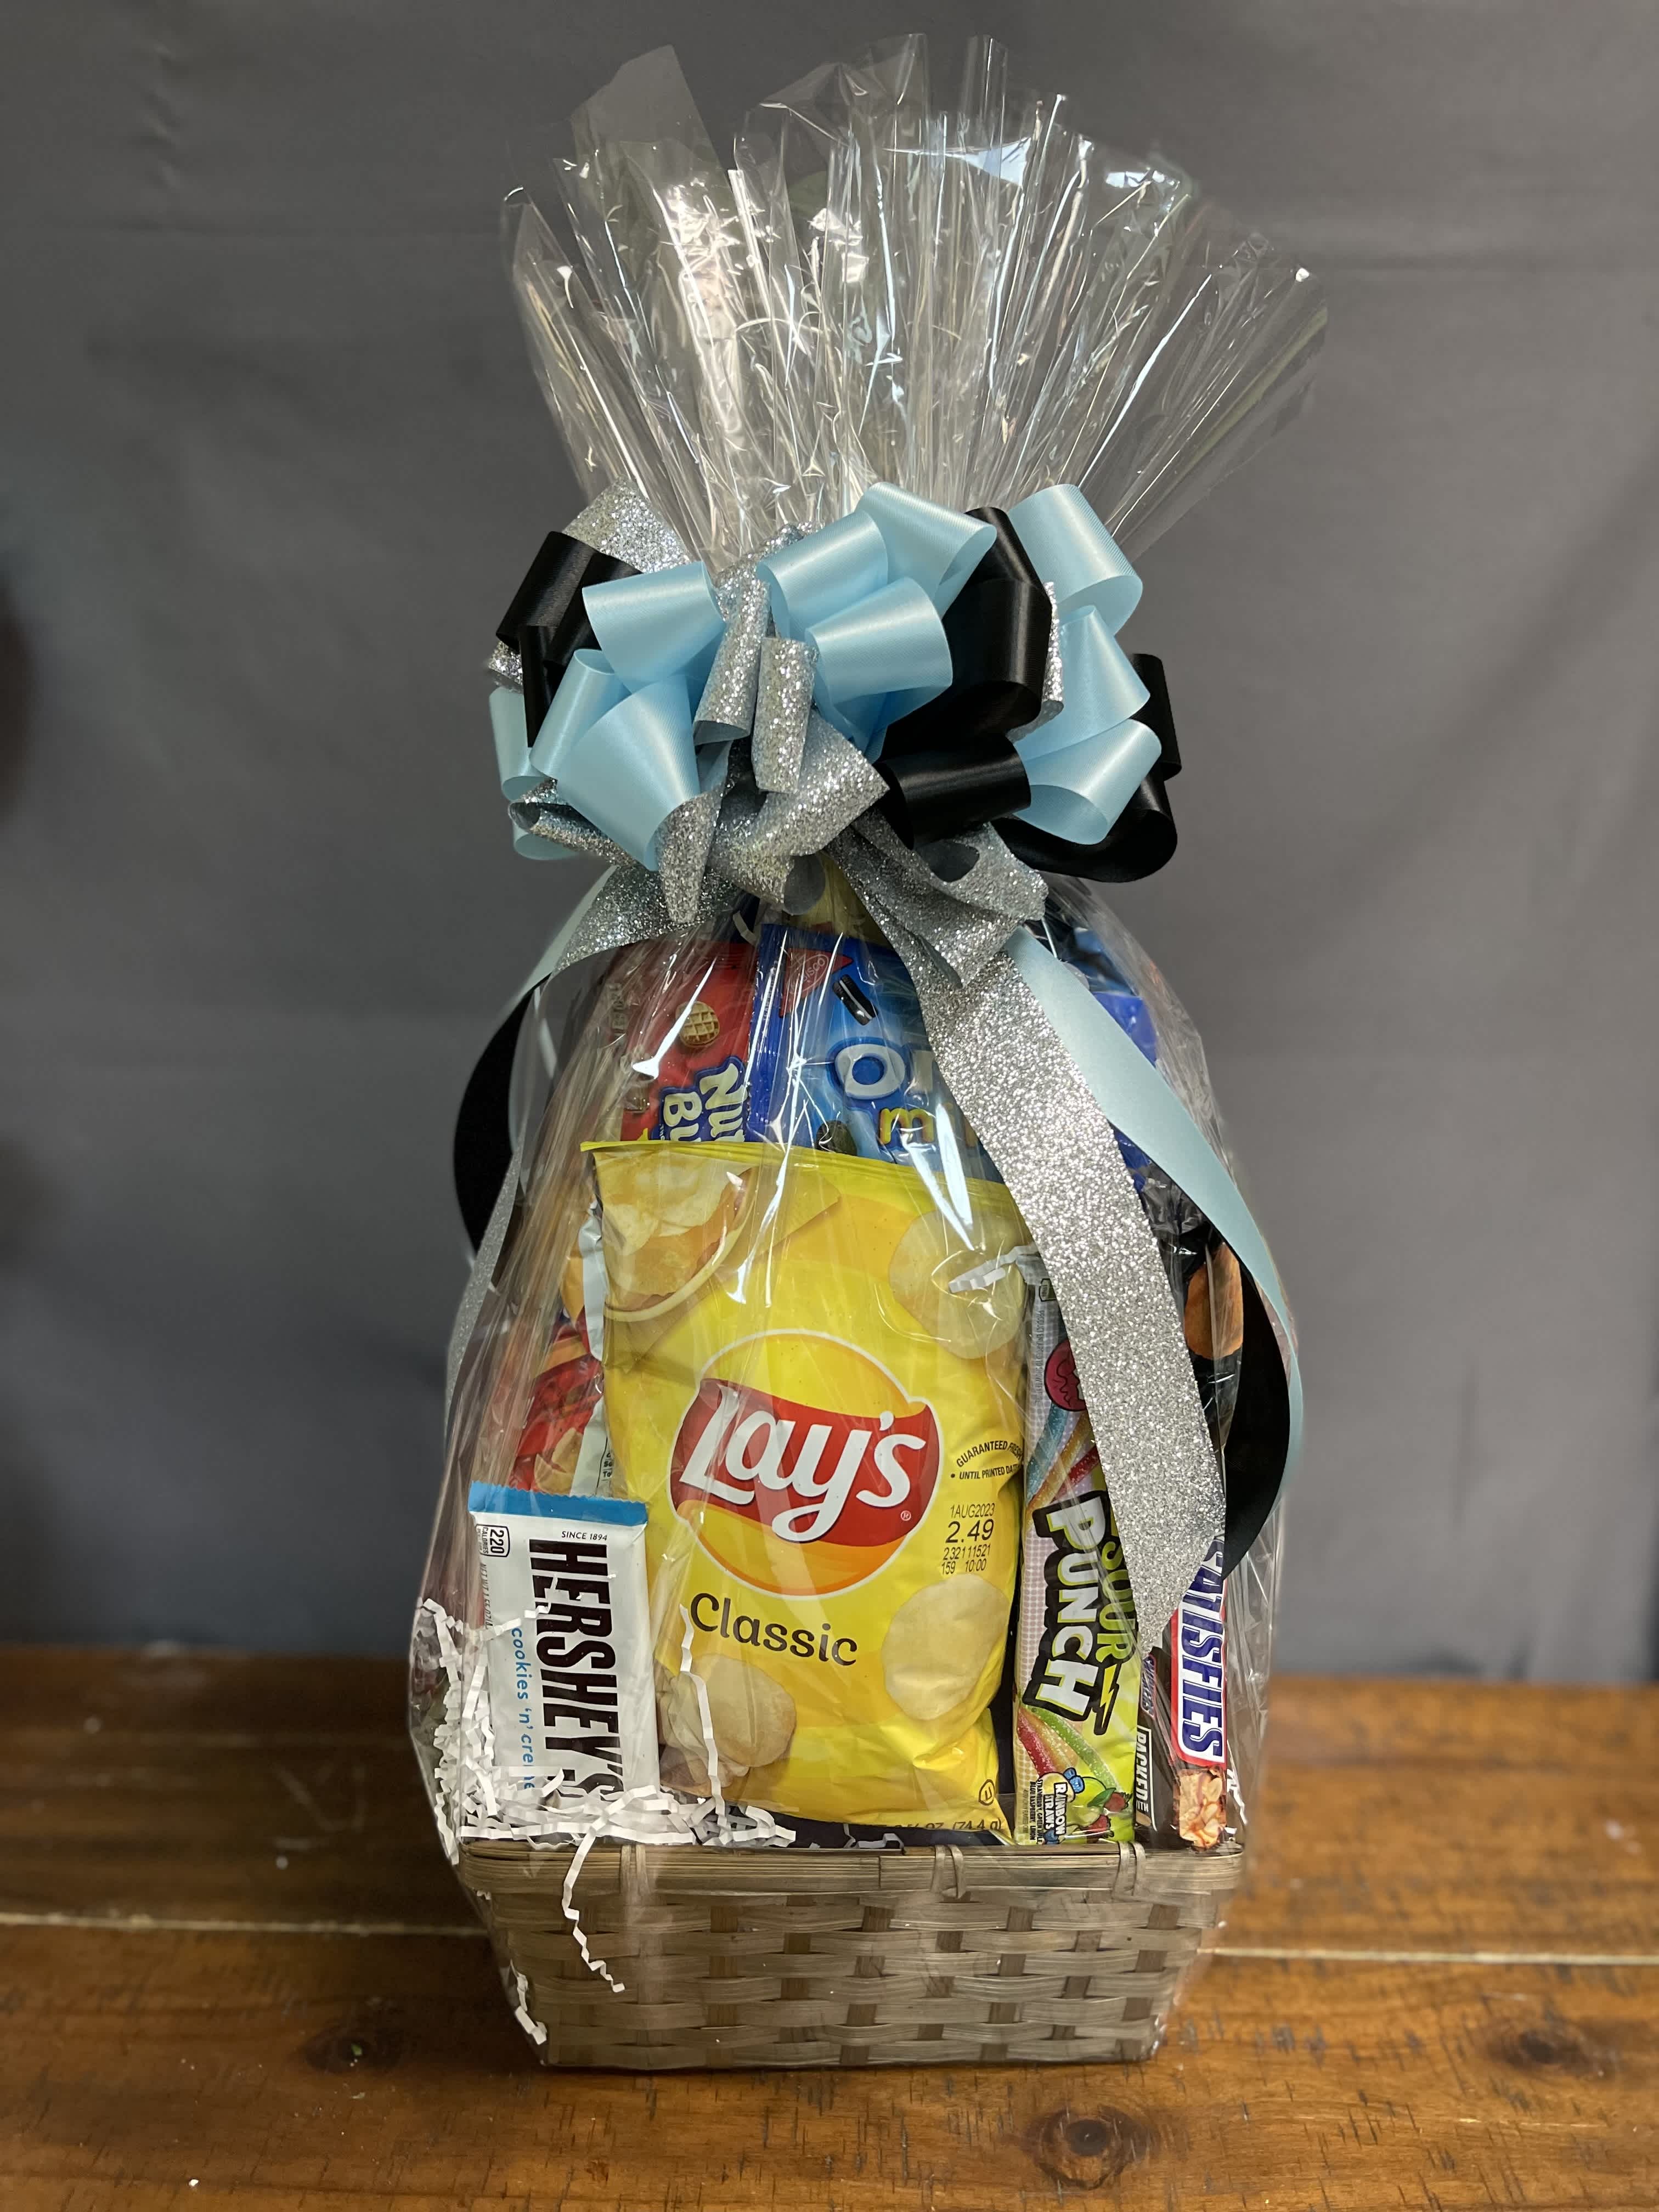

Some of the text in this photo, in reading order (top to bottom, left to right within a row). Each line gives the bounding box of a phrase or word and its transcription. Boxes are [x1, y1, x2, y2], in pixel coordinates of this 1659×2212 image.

[679, 1384, 927, 1542] Lay's
[956, 1440, 1008, 1468] GUARANTEED
[959, 1471, 980, 1480] UNTIL
[981, 1466, 1005, 1479] PRINTED
[945, 1518, 994, 1543] 2.49
[950, 1502, 995, 1519] 1AUG2023
[490, 1528, 504, 1554] 220
[561, 1531, 607, 1541] SINCE 1894
[941, 1558, 987, 1575] 159 10:00
[1035, 1497, 1106, 1716] PUNCH
[1096, 1541, 1136, 1663] SOUR
[690, 1593, 857, 1667] Classic
[511, 1628, 532, 1700] cookies
[520, 1733, 535, 1790] cree
[1136, 1732, 1148, 1801] PACKED
[1044, 1794, 1054, 1830] STRAWS
[1054, 1783, 1067, 1835] RAINBOW
